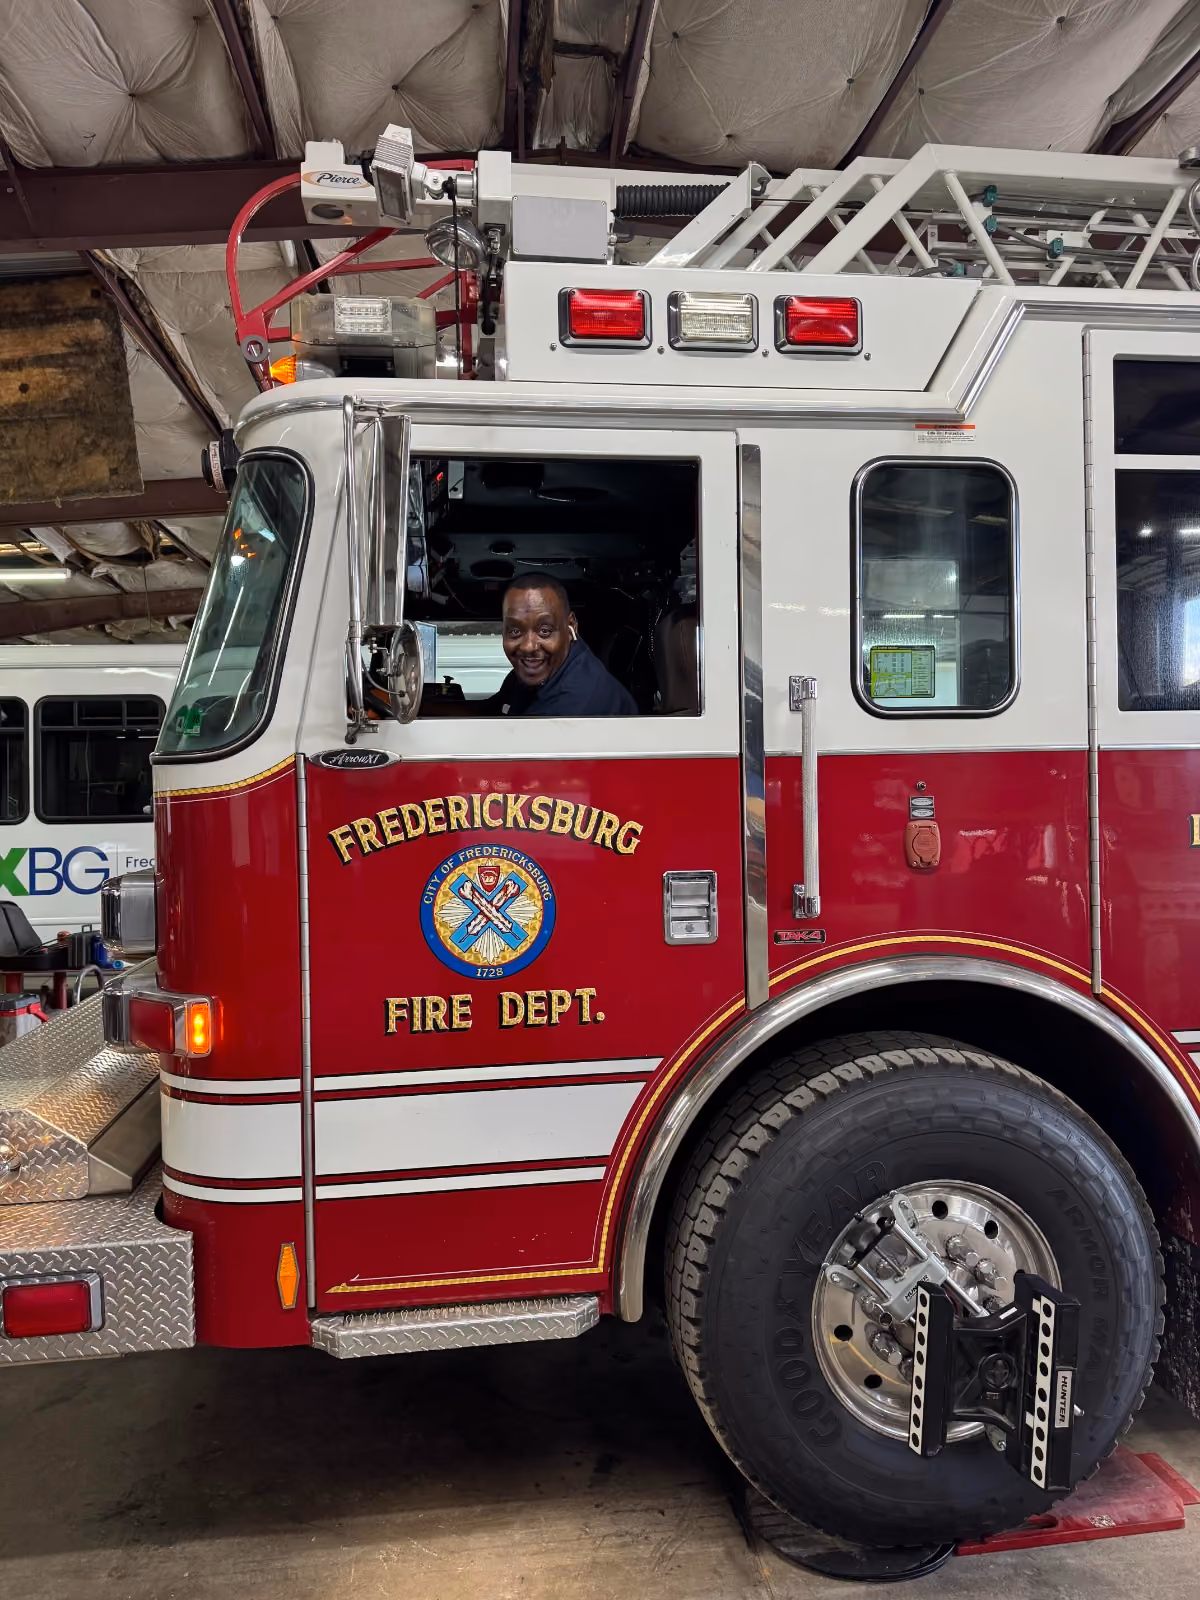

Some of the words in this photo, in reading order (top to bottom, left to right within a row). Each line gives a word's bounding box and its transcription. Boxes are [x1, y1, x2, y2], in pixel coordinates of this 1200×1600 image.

[316, 172, 361, 185] Pierce
[328, 793, 644, 866] FREDERICKSBURG
[423, 875, 441, 905] CITY
[440, 858, 456, 874] OF
[458, 846, 552, 901] FREDERICKSBURG
[476, 967, 504, 978] 1728
[384, 994, 473, 1036] FIRE
[498, 988, 606, 1029] DEPT.
[1058, 1375, 1069, 1424] HUNTER
